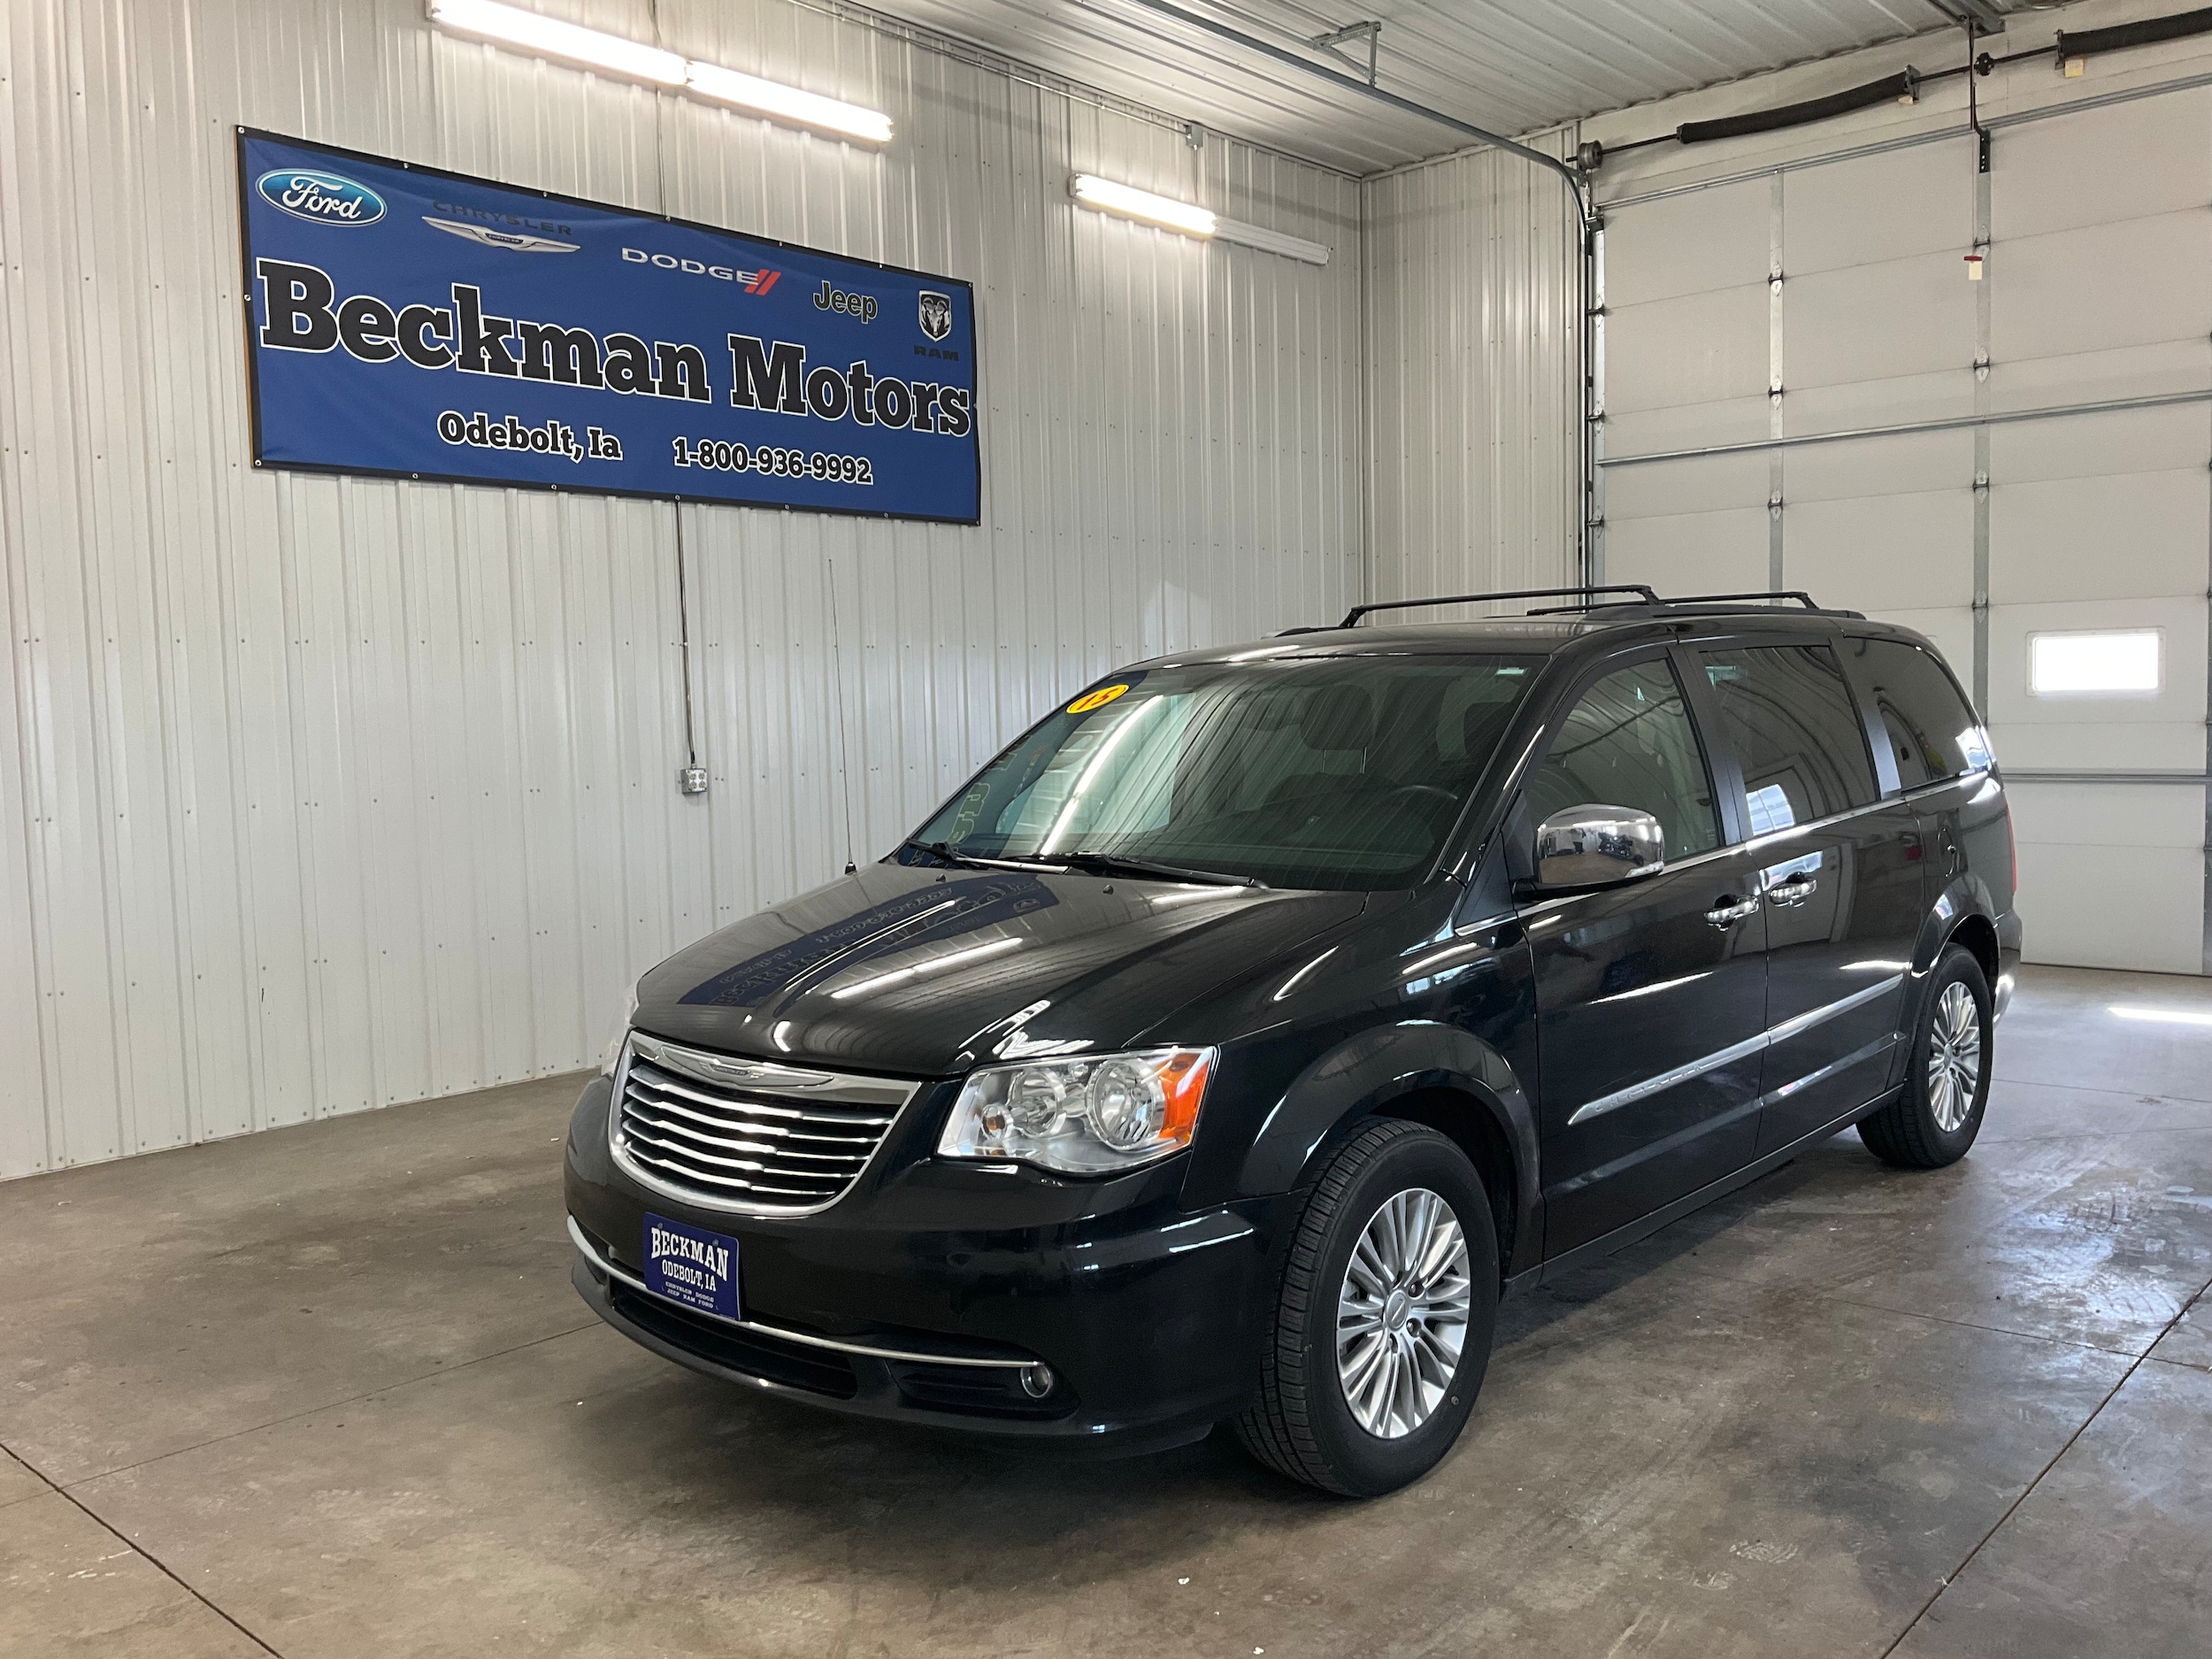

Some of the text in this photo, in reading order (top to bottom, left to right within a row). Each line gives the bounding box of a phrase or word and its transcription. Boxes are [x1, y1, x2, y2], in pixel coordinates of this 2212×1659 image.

[281, 176, 363, 219] Ford
[432, 201, 572, 236] CHRYSLER
[621, 247, 759, 286] DODGE
[813, 280, 879, 325] Jeep
[257, 257, 972, 438] Beckman Motors
[913, 344, 960, 362] RAM
[437, 410, 873, 486] Odebolt, Ia 1-800-936-9992
[650, 1226, 729, 1282] BECKMAN
